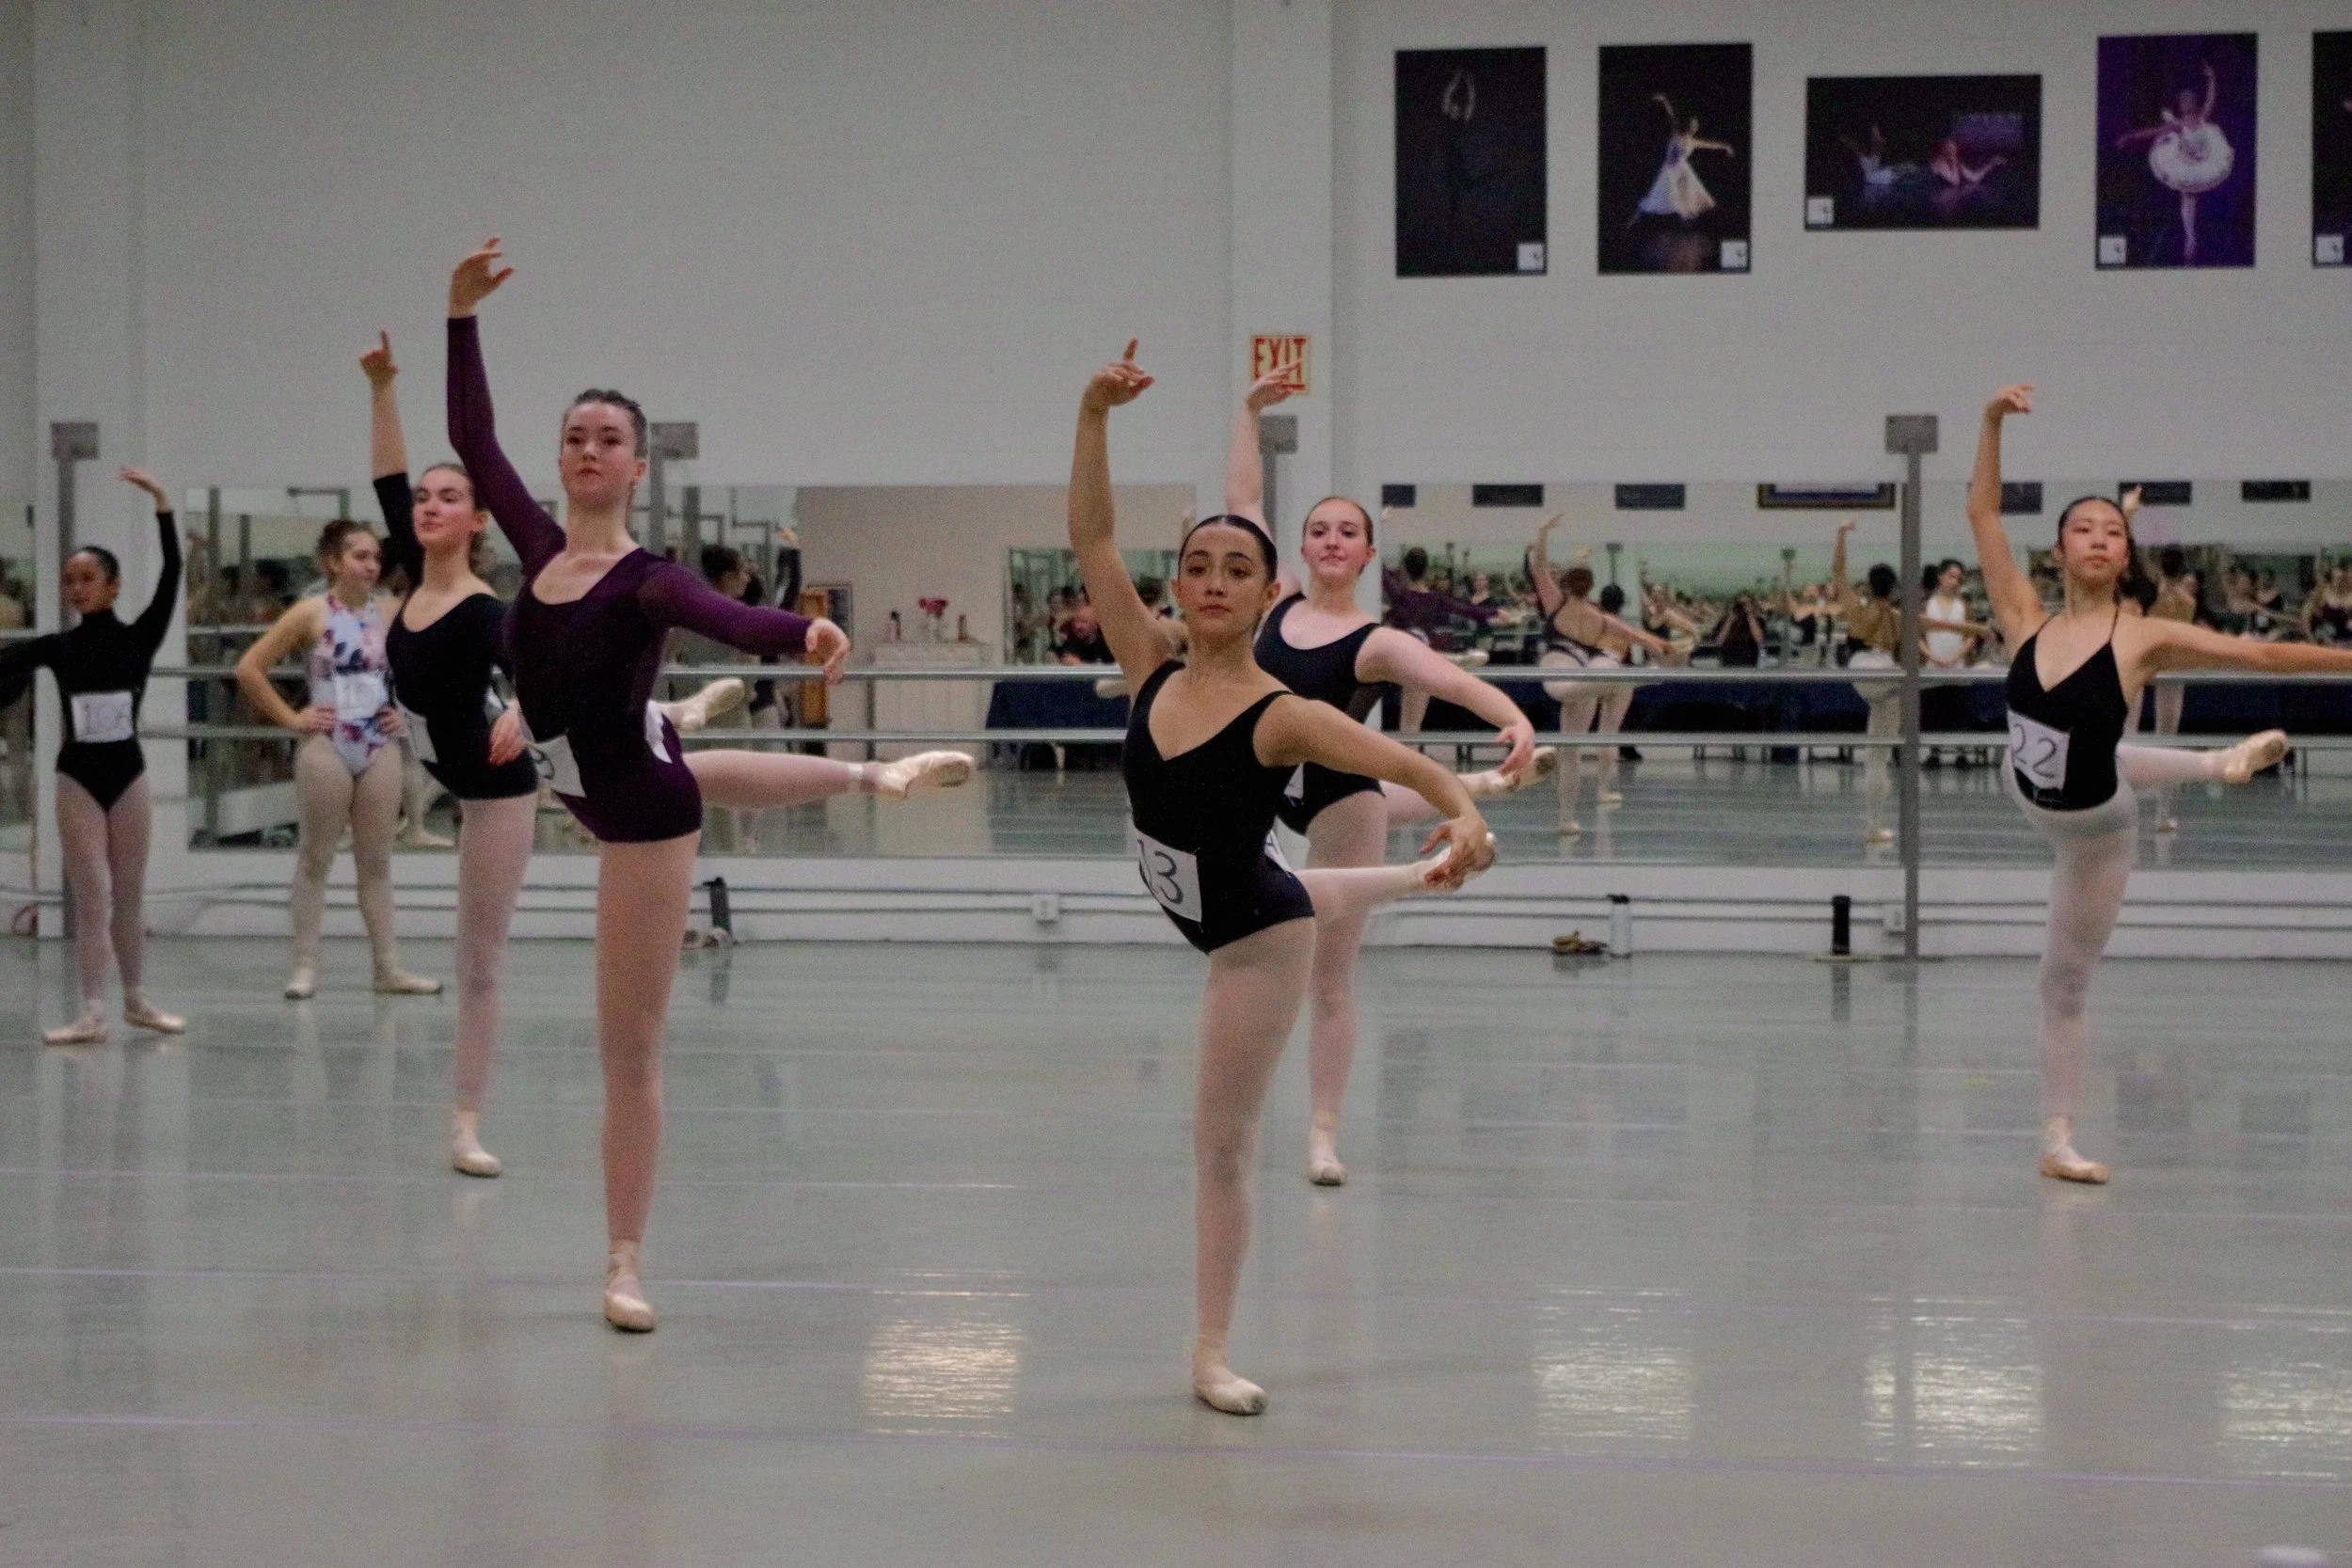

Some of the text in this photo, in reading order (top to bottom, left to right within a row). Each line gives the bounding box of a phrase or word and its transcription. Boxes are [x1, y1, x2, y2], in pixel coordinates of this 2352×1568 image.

[1253, 337, 1307, 384] EXIT
[2011, 723, 2058, 779] 22
[1136, 839, 1184, 905] 13
